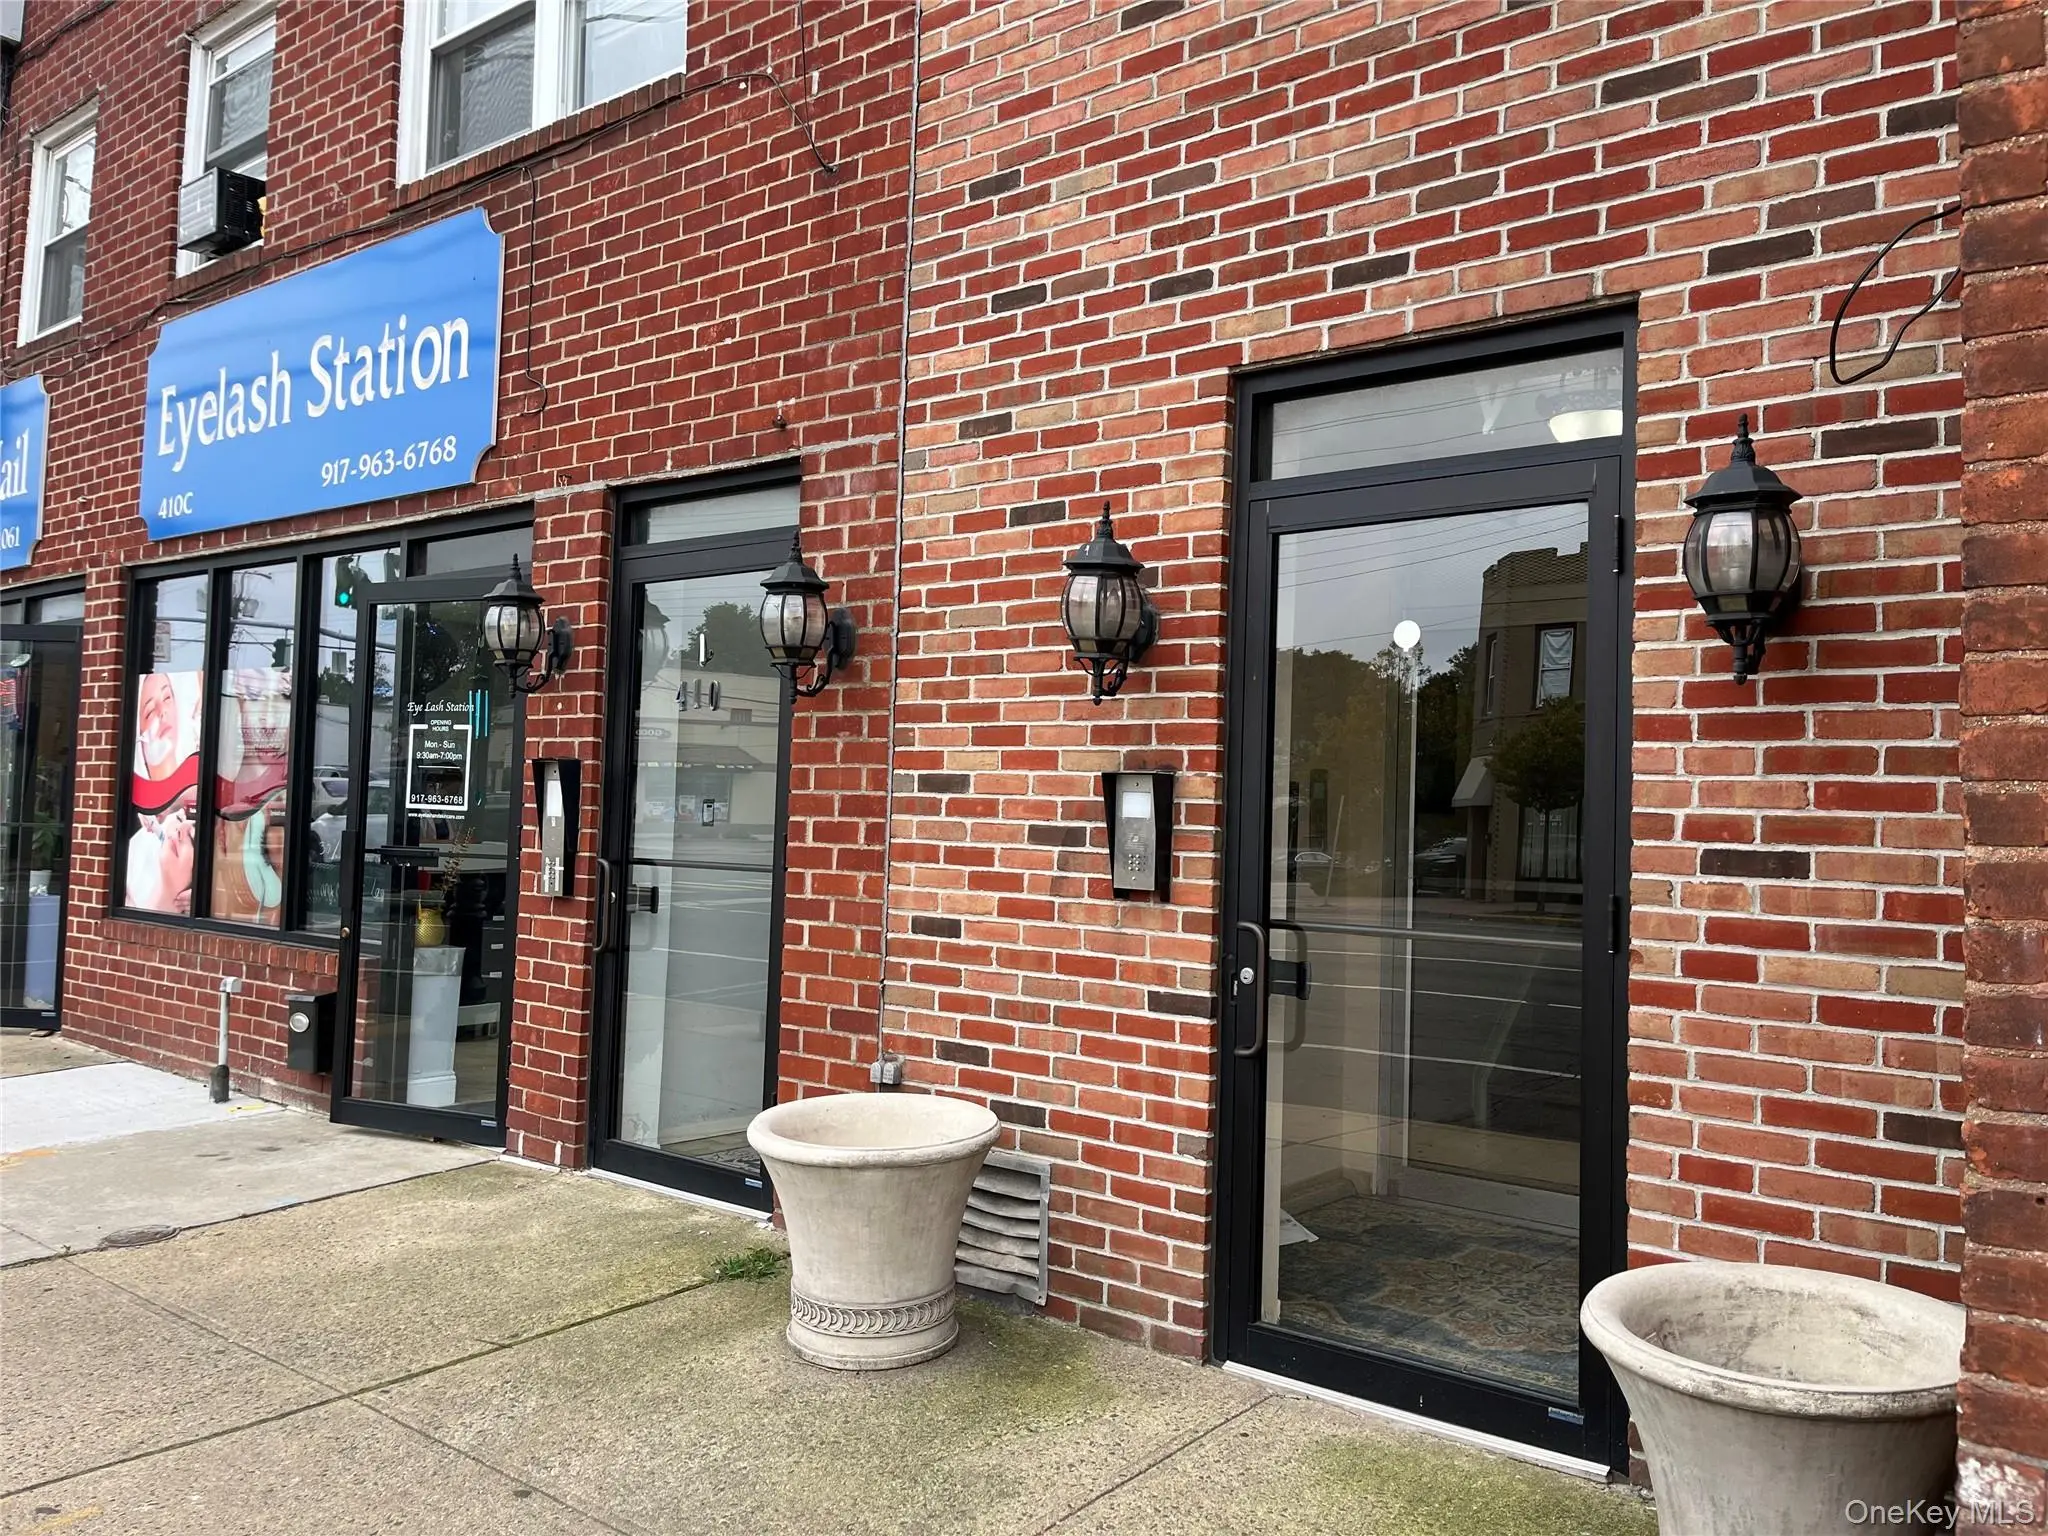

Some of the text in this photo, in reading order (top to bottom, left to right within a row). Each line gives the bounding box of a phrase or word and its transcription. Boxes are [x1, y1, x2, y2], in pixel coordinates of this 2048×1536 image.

[157, 314, 469, 473] Eyelash Station
[0, 427, 29, 501] ail
[321, 435, 457, 487] 917-963-6768
[158, 491, 193, 519] 410C
[0, 525, 20, 551] 061
[407, 700, 474, 716] Eye Lash Station
[675, 679, 720, 711] 410
[416, 751, 462, 761] 9:30am-7:00pm
[424, 740, 438, 748] Mon
[443, 740, 455, 748] Sun
[411, 794, 463, 804] 917-963-6768
